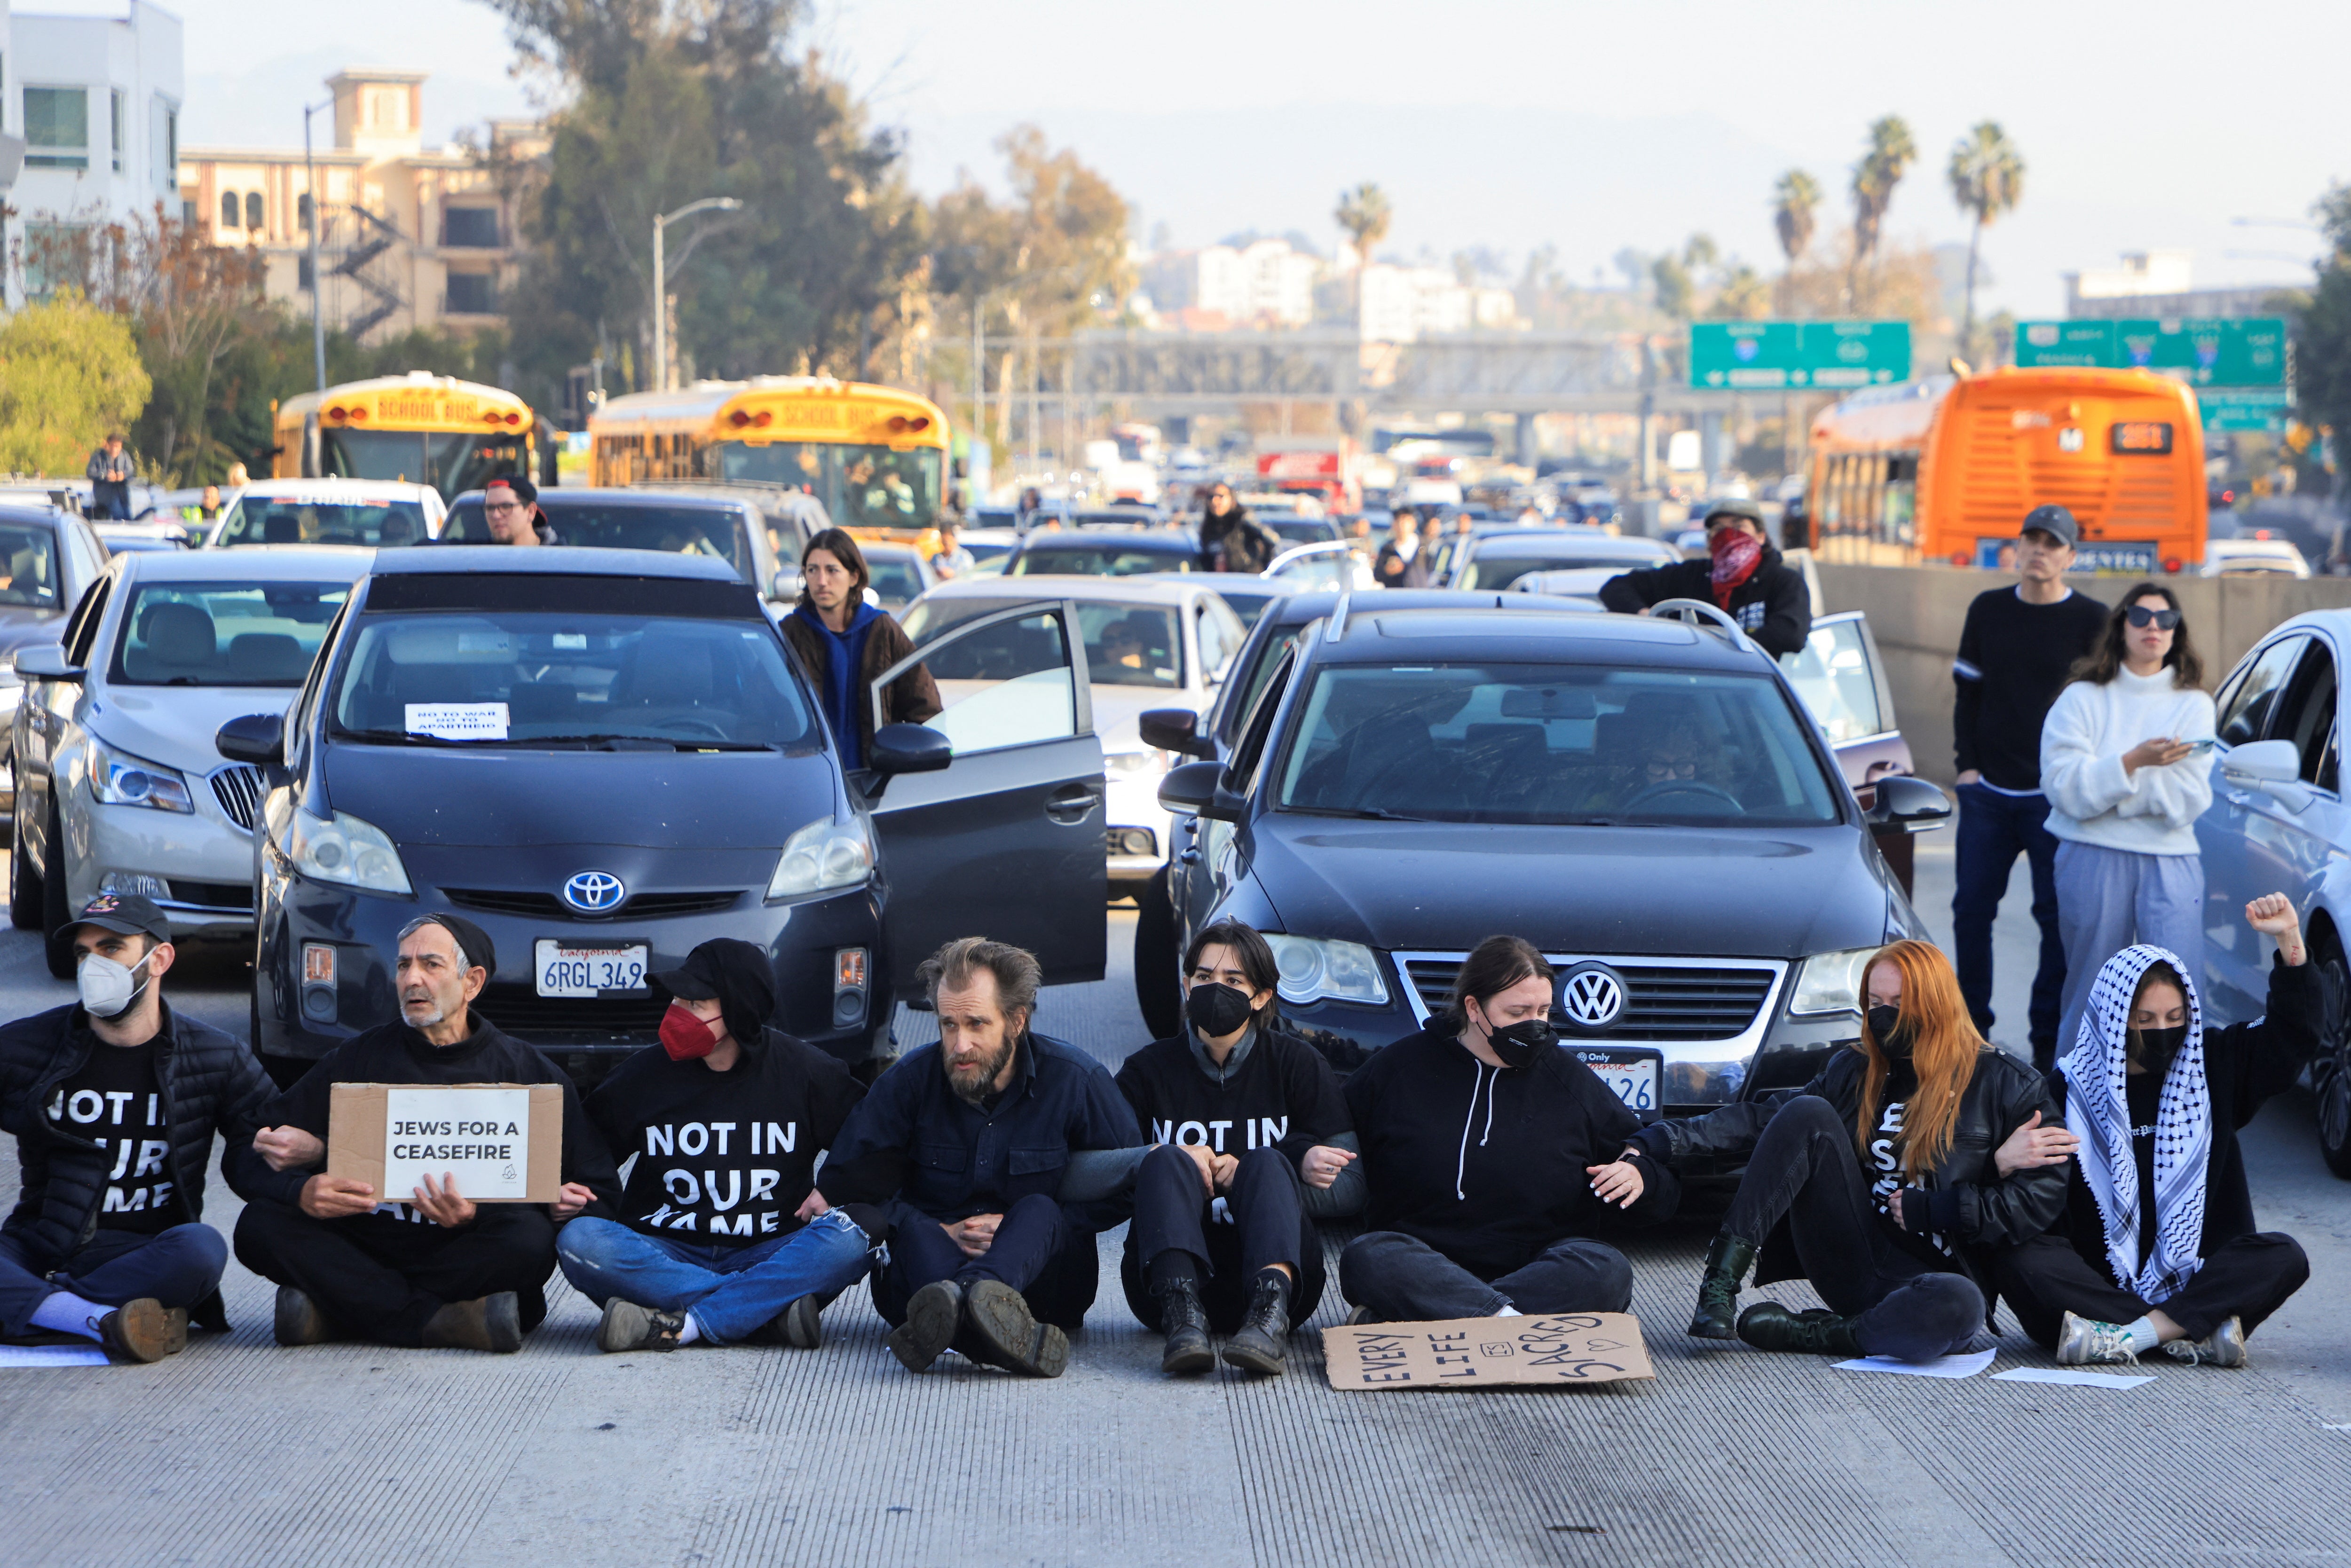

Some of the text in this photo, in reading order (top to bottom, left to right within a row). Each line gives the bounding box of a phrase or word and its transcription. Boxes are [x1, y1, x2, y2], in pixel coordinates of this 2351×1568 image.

[378, 398, 476, 420] SCHOOL BUS
[782, 404, 875, 427] SCHOOL BUS
[545, 962, 642, 988] 6RGL349
[1588, 1053, 1610, 1063] Only
[1589, 1063, 1635, 1072] ornia
[394, 1121, 520, 1135] JEWS FOR A
[646, 1122, 796, 1156] NOT IN
[1152, 1115, 1288, 1152] NOT IN
[94, 1137, 169, 1180] UR
[394, 1144, 511, 1159] CEASEFIRE
[663, 1168, 781, 1211] OUR
[639, 1203, 780, 1237] NAME
[1353, 1333, 1414, 1382] EVERY
[1428, 1332, 1476, 1377] LIFE
[1487, 1344, 1507, 1355] IS
[1518, 1316, 1626, 1378] SACRED
